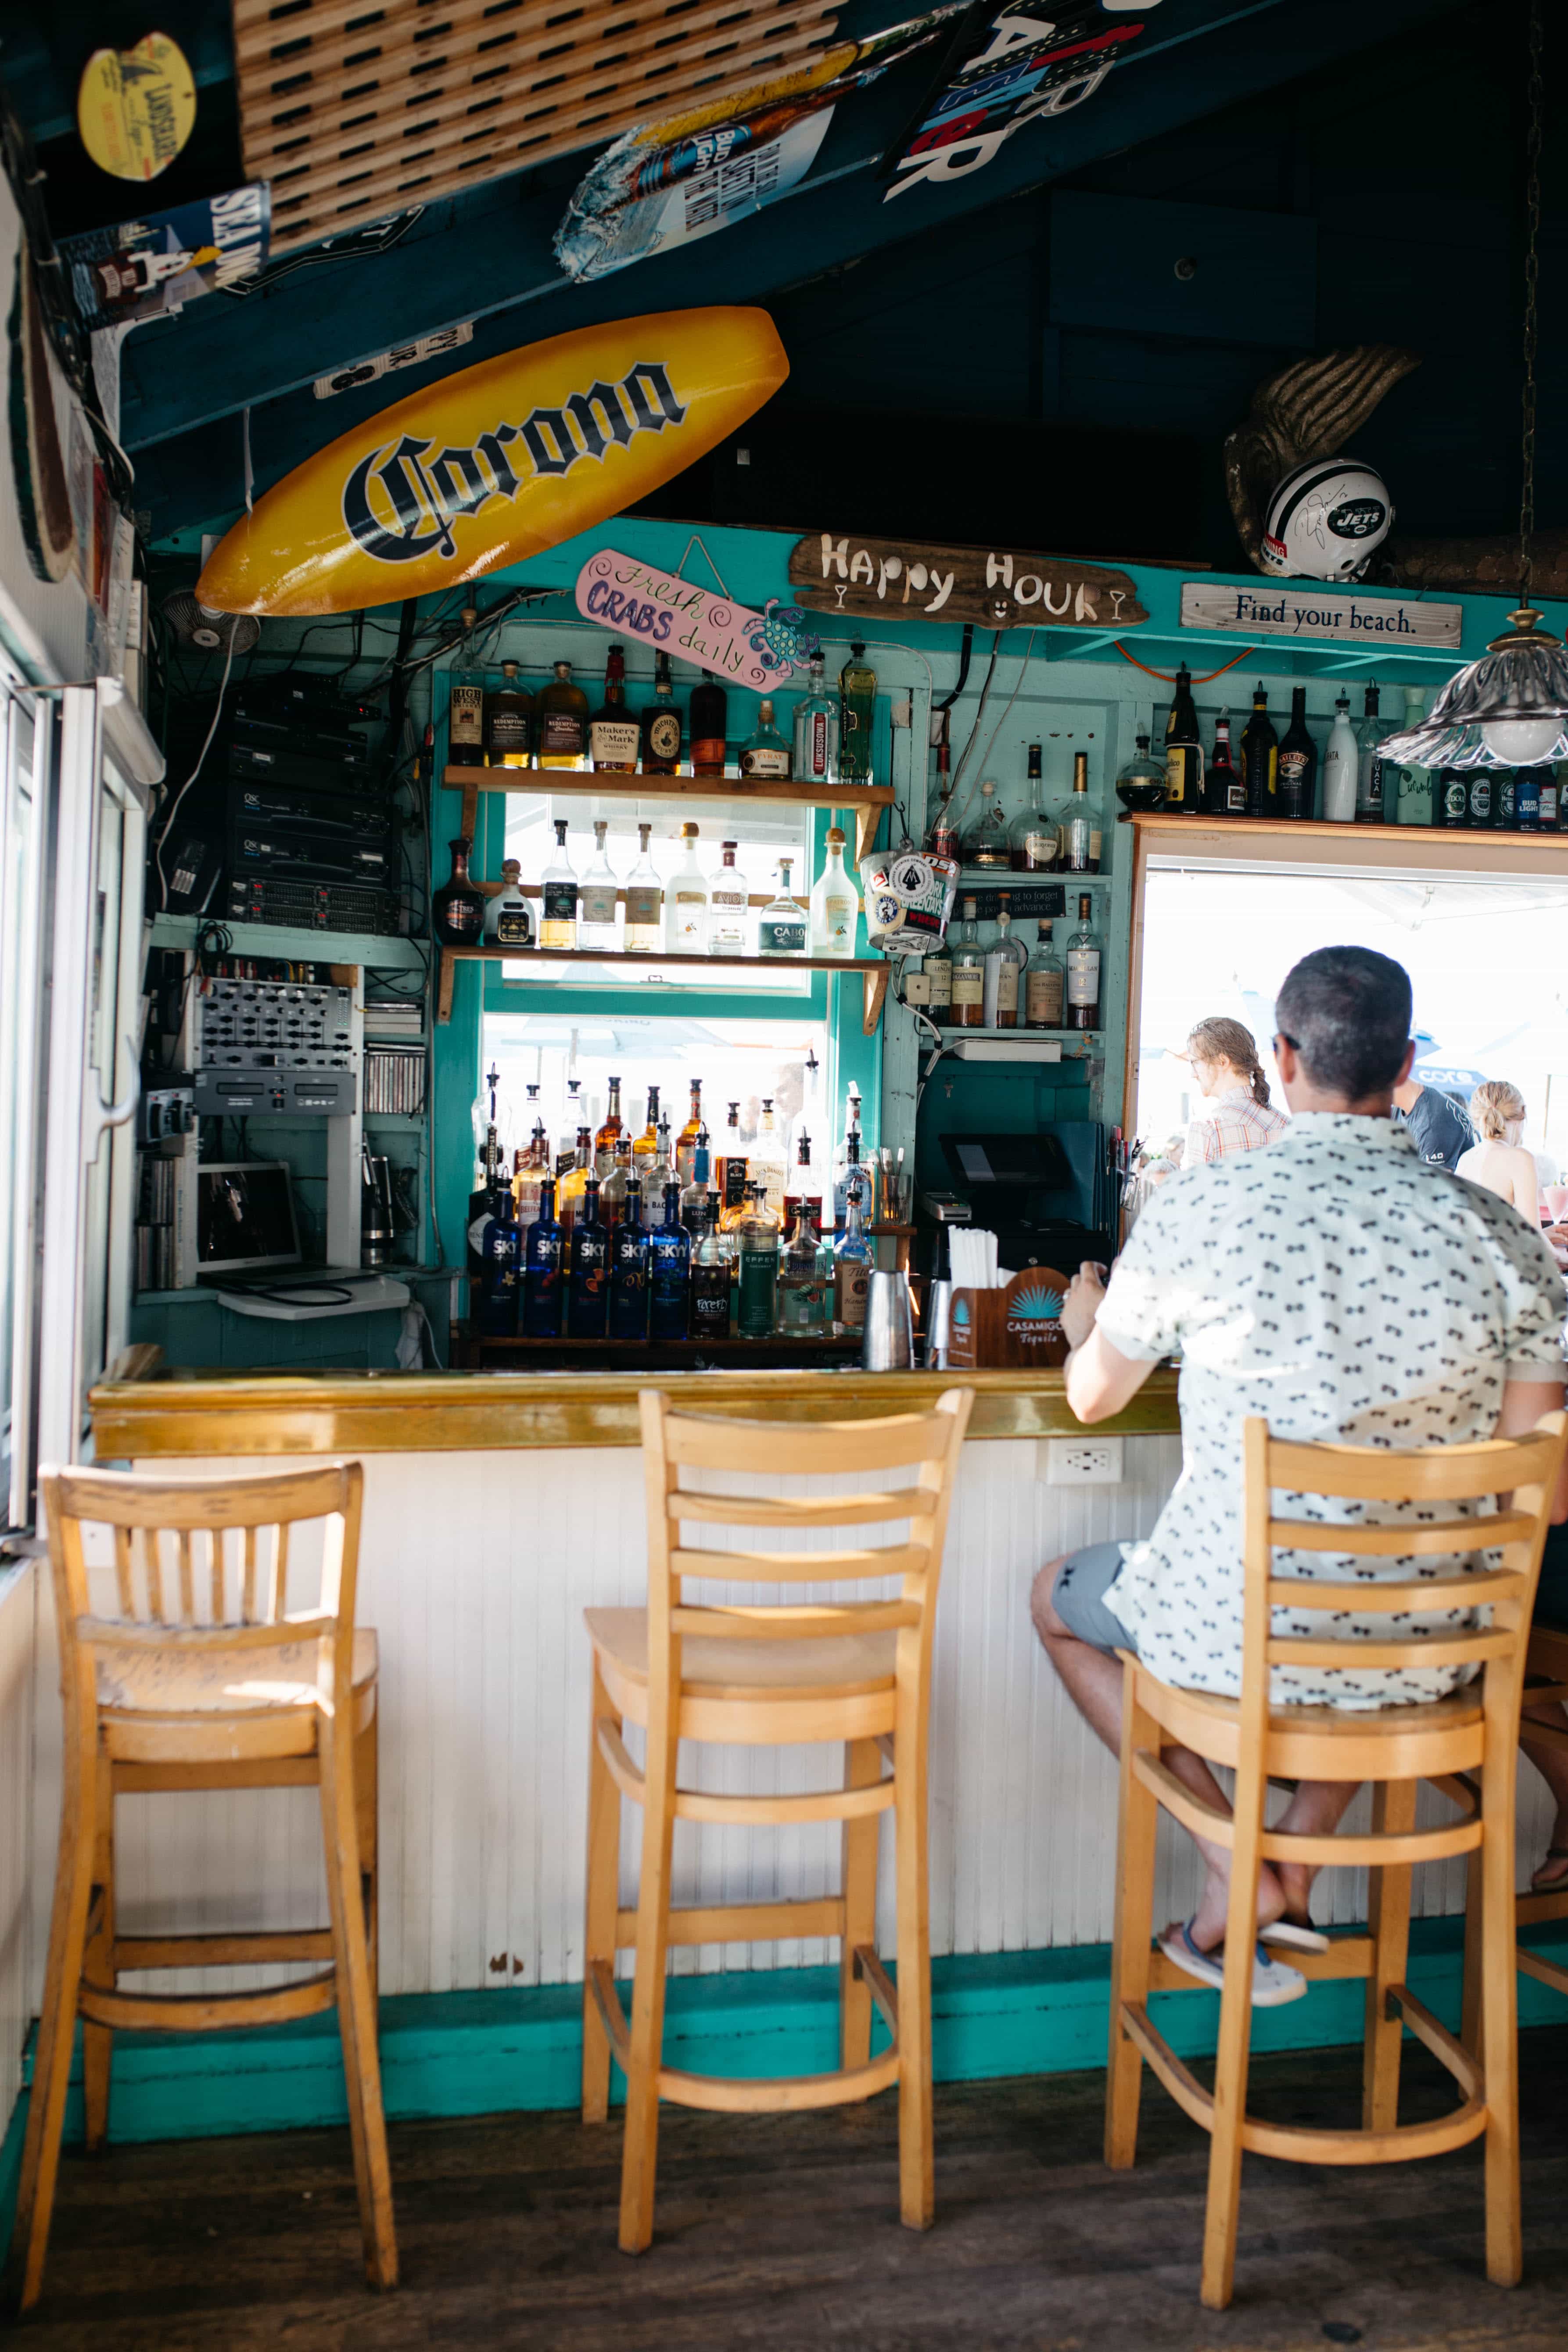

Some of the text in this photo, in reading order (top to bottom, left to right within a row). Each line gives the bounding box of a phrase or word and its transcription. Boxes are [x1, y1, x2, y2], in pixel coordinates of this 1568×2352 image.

[714, 130, 736, 163] BUD
[684, 170, 718, 200] THE
[721, 155, 756, 198] SAFETY
[211, 188, 262, 240] SEA
[341, 361, 690, 563] Corona
[1337, 512, 1380, 527] JETS
[615, 565, 705, 620] Fresh
[986, 552, 1102, 622] HOUR
[587, 579, 673, 641] CRABS
[1235, 594, 1417, 634] Find your beach.
[678, 626, 745, 674] daily
[453, 688, 482, 698] HIGH
[598, 726, 635, 735] Maker's
[608, 735, 635, 744] Mark
[814, 722, 825, 767] LUKSUSOWA
[1014, 903, 1051, 912] advance.
[1034, 891, 1058, 903] forget
[774, 927, 805, 937] CABO
[1007, 1321, 1064, 1331] CASAMIGO
[1019, 1333, 1057, 1346] Tequila
